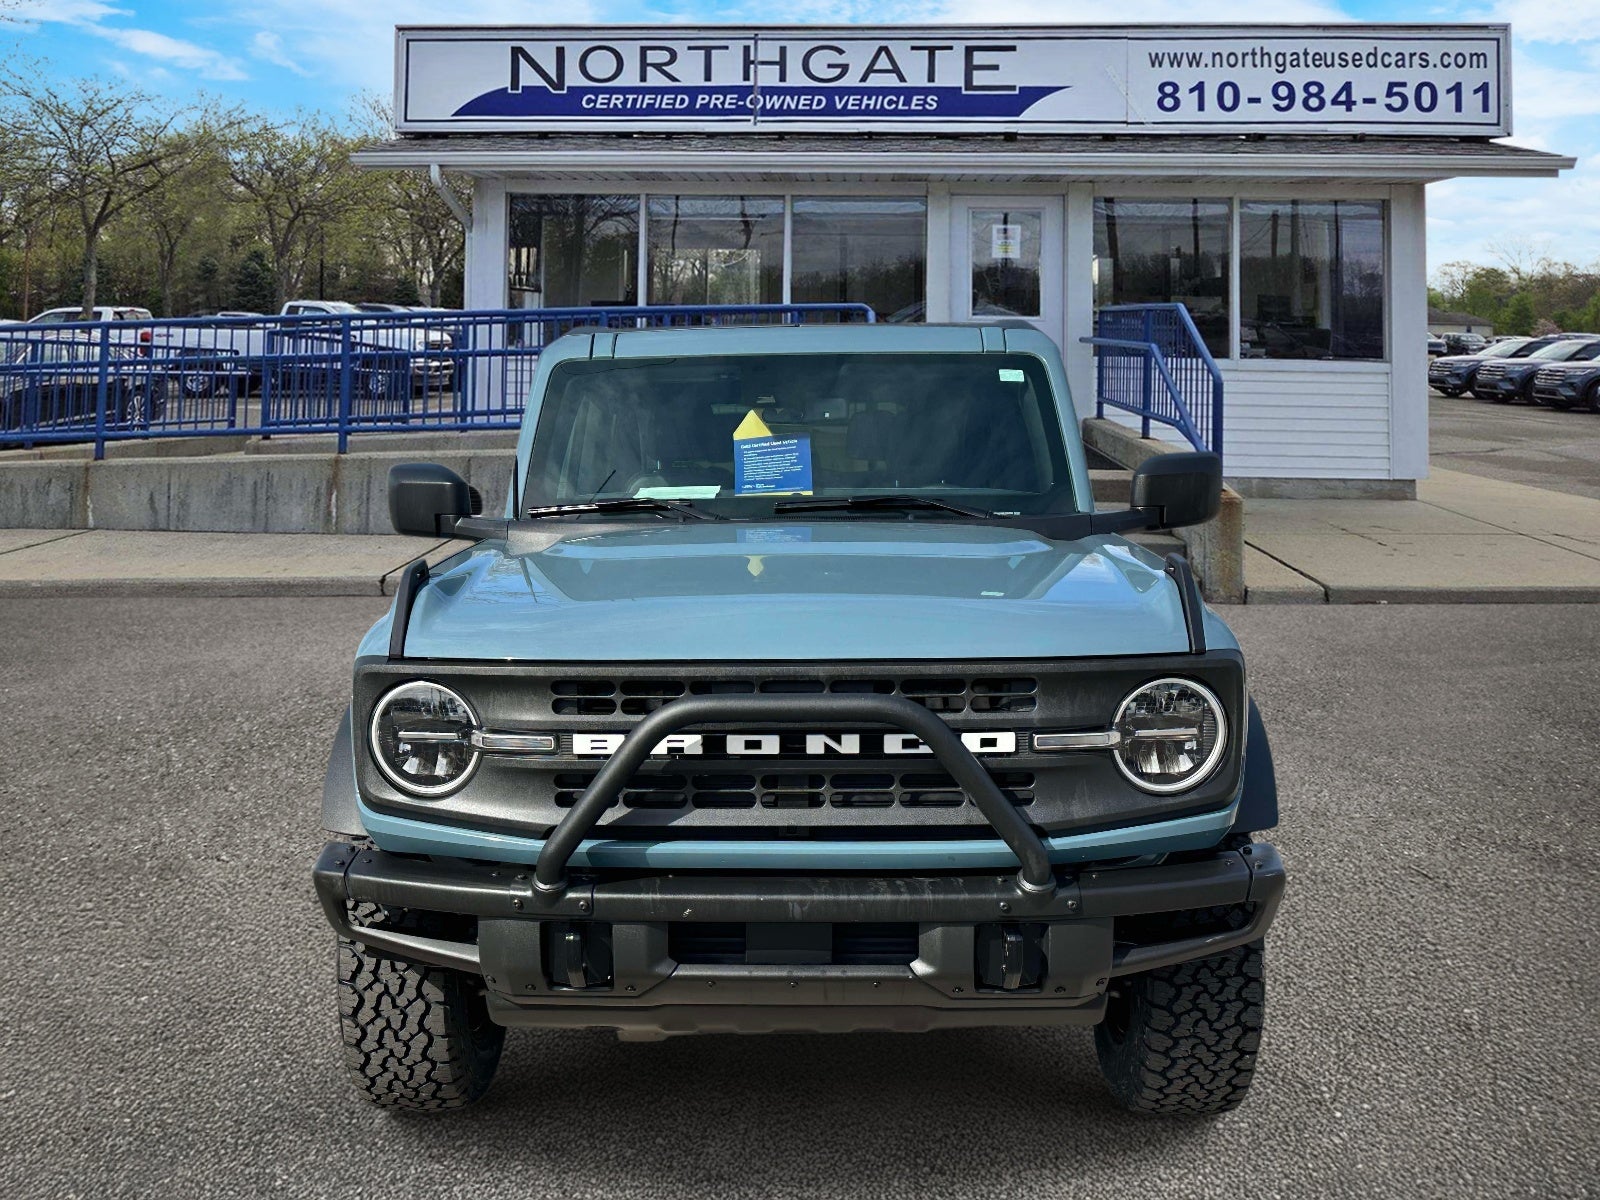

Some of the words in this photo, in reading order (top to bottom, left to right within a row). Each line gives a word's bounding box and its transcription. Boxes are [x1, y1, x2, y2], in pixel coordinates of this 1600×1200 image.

[510, 44, 1017, 93] NORTHGATE
[1148, 47, 1488, 73] www.northgateusedcars.com
[581, 94, 689, 110] CERTIFIED
[695, 95, 827, 111] PRE-OWNED
[834, 95, 939, 111] VEHICLES
[1156, 80, 1491, 113] 810-984-5011
[572, 732, 1016, 755] BRONCO
